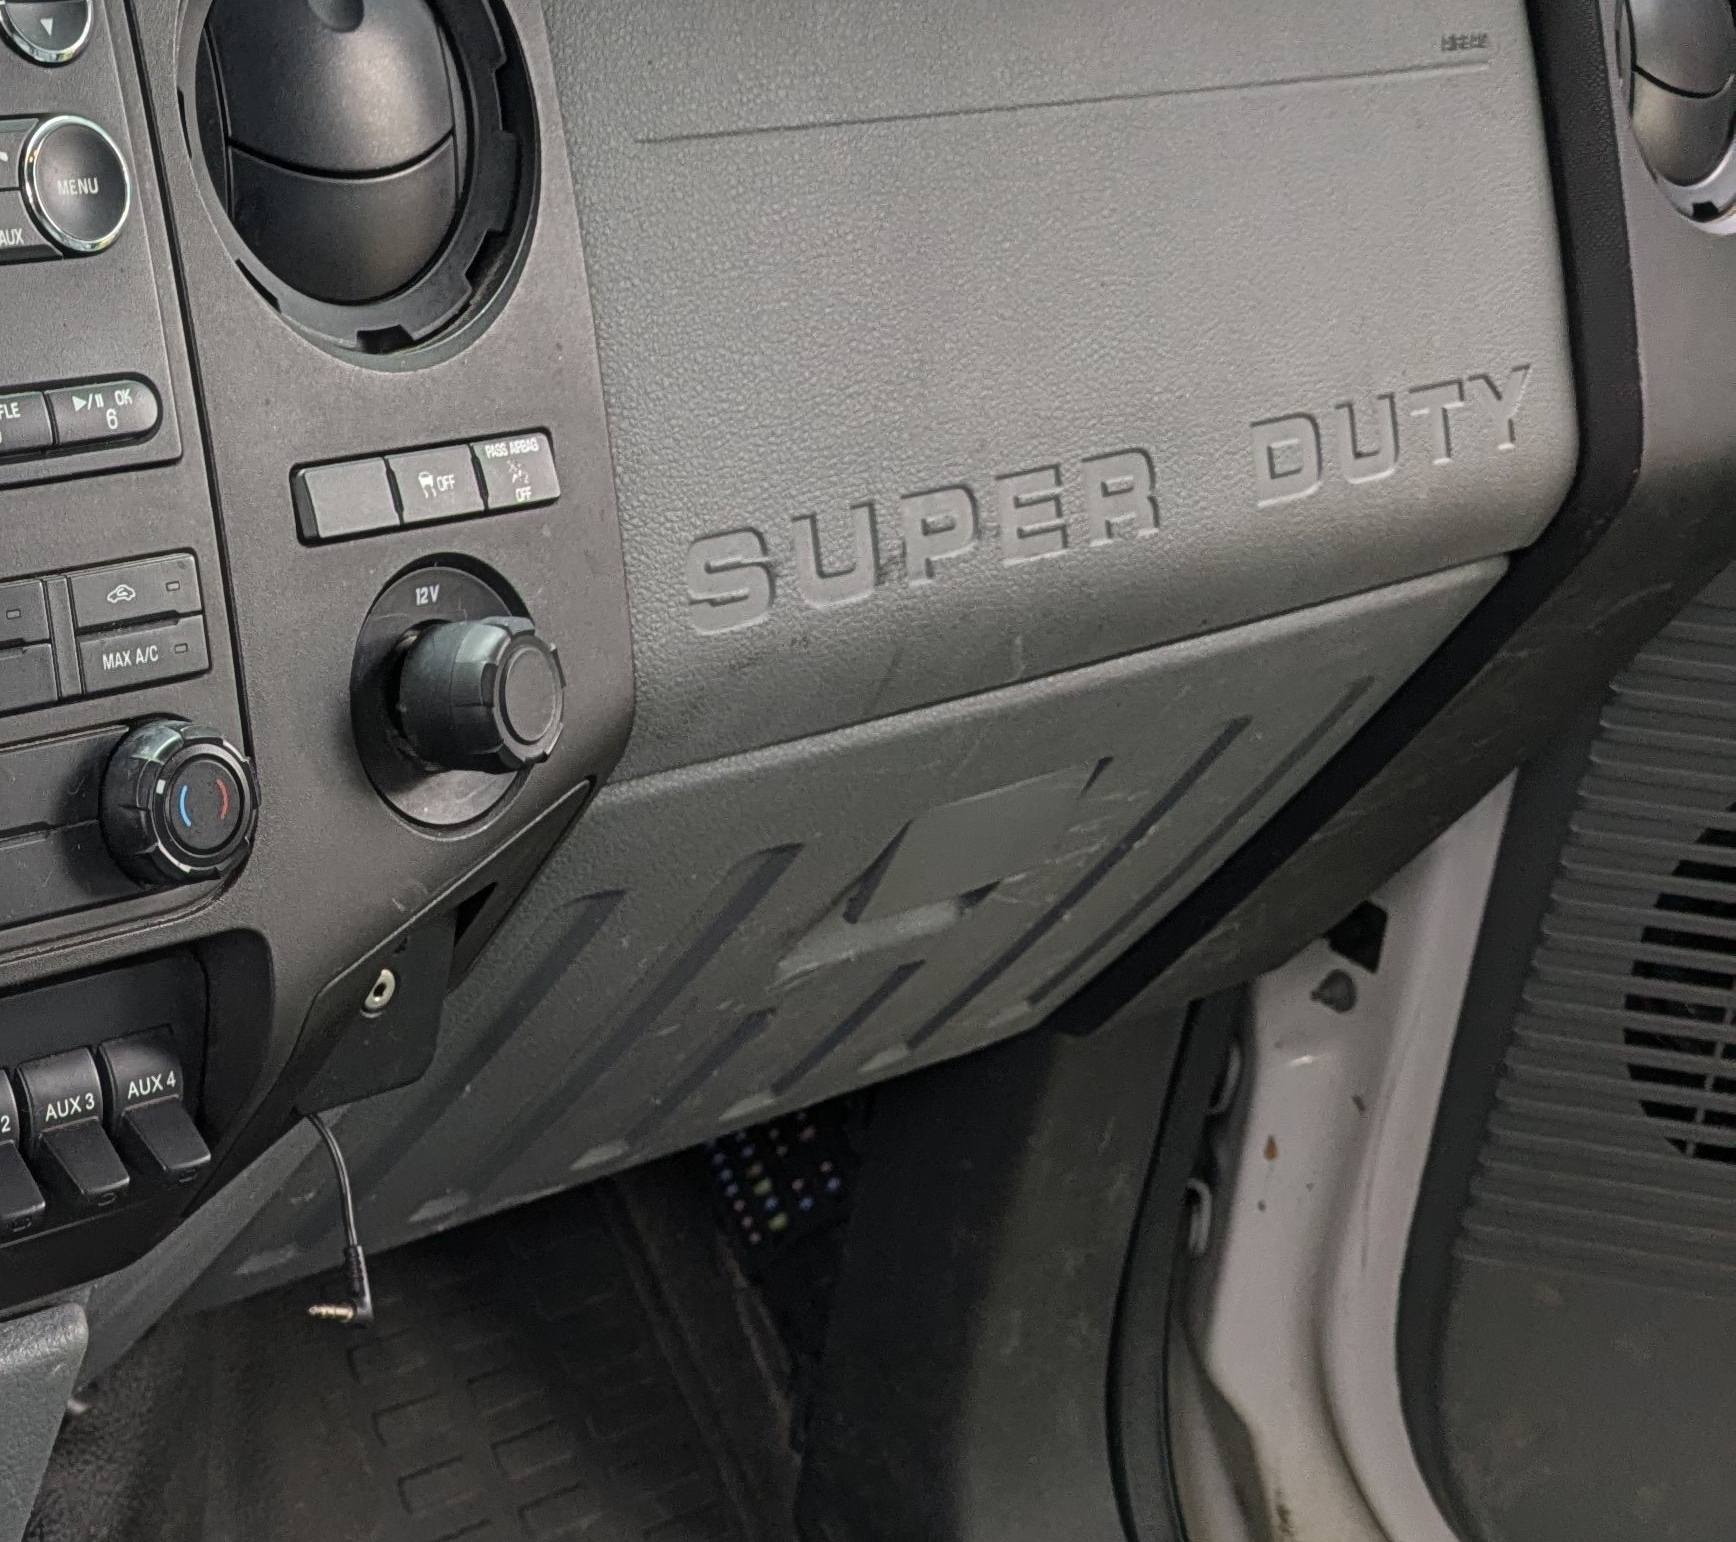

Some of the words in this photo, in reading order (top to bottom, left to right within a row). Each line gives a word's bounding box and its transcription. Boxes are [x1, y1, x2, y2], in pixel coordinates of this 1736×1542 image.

[57, 176, 100, 196] MENU
[114, 388, 133, 407] OK
[105, 407, 119, 430] 6
[484, 443, 509, 459] PASS
[436, 474, 456, 492] OFF
[515, 486, 532, 502] OFF
[682, 445, 1162, 636] SUPER
[1248, 362, 1532, 508] DUTY
[415, 584, 440, 606] 12V
[102, 649, 132, 671] MAX
[135, 644, 160, 666] A/C
[126, 1073, 165, 1100] AUX
[166, 1070, 177, 1089] 4
[44, 1095, 83, 1123] AUX
[85, 1092, 96, 1111] 3
[1, 1115, 12, 1134] 2
